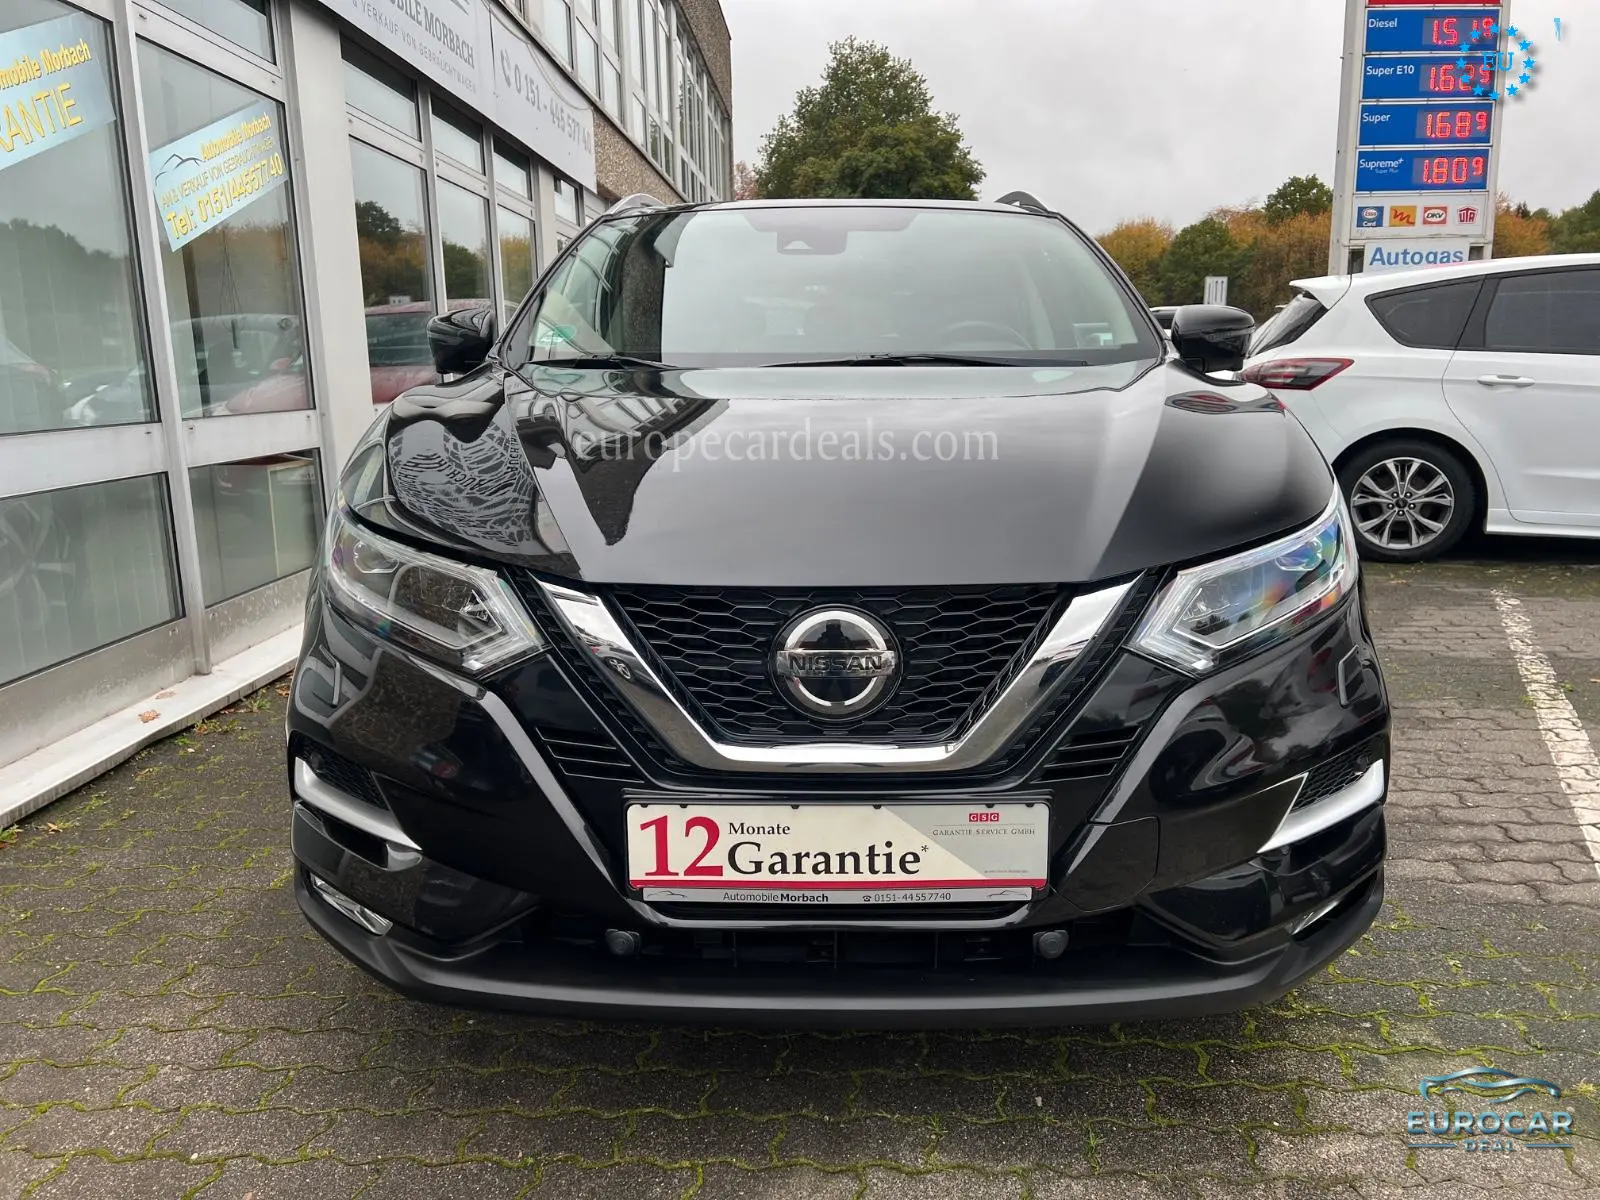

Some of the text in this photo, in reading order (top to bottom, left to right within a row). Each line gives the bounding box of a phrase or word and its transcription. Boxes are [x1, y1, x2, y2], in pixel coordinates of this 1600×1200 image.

[360, 0, 400, 36] VERKAUF
[401, 29, 417, 50] VON
[1368, 18, 1398, 28] Diesel
[390, 0, 475, 70] BILE MORBACH
[40, 37, 92, 75] Morbach
[1366, 65, 1393, 76] Super
[1396, 65, 1415, 75] E10
[525, 73, 541, 112] 151
[1362, 112, 1391, 124] Super
[167, 204, 197, 240] Tel:
[1426, 210, 1443, 219] DKV
[1369, 247, 1464, 266] Autogas
[787, 655, 882, 673] NISSAN
[969, 813, 1000, 822] GSG
[640, 815, 791, 877] 12 Monate
